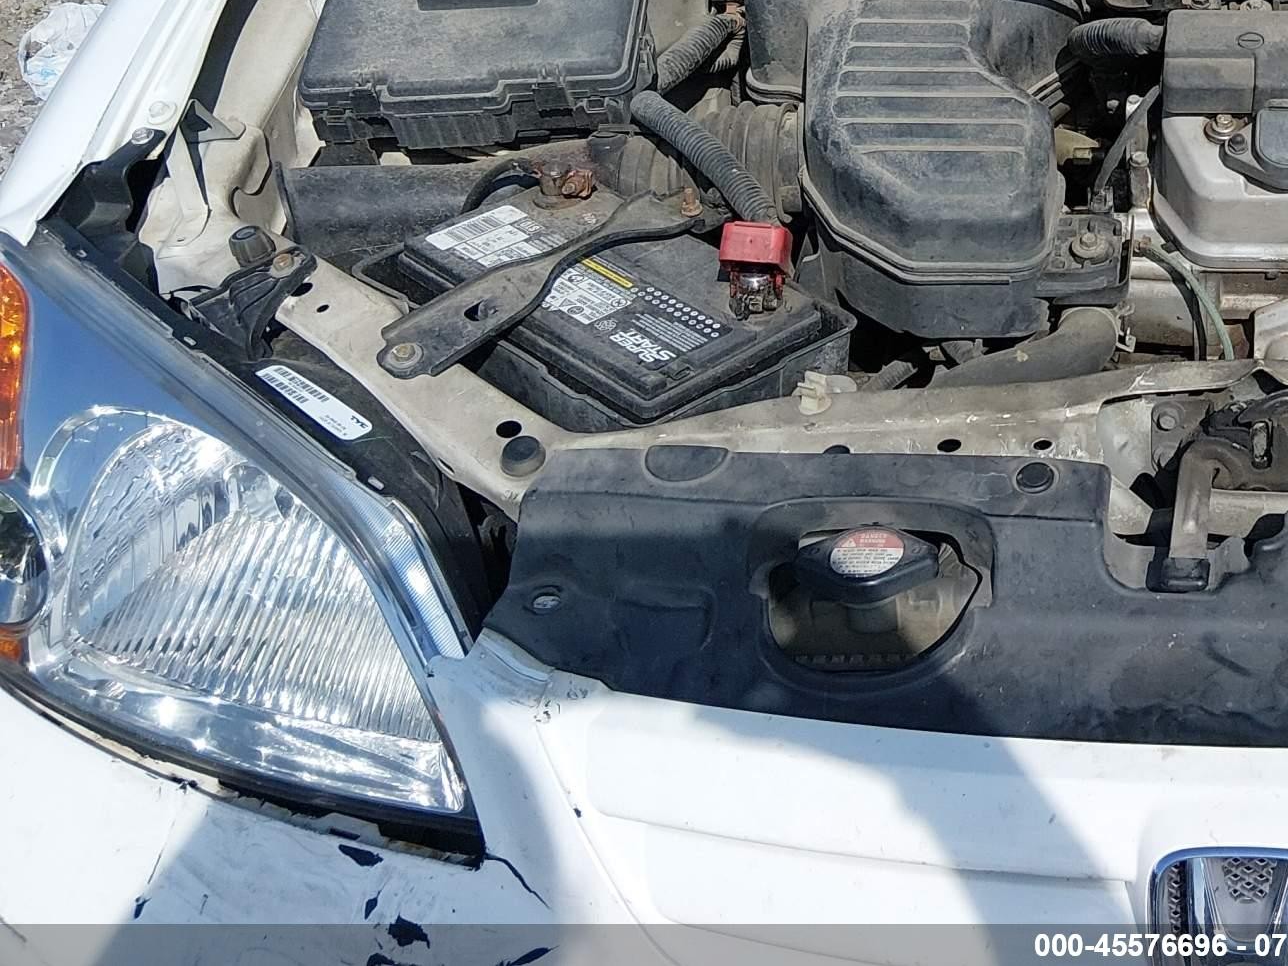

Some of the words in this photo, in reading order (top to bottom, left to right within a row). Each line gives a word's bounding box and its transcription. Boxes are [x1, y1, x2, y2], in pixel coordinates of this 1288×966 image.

[609, 333, 656, 363] SUPER
[618, 328, 678, 361] START
[351, 415, 369, 429] TYC
